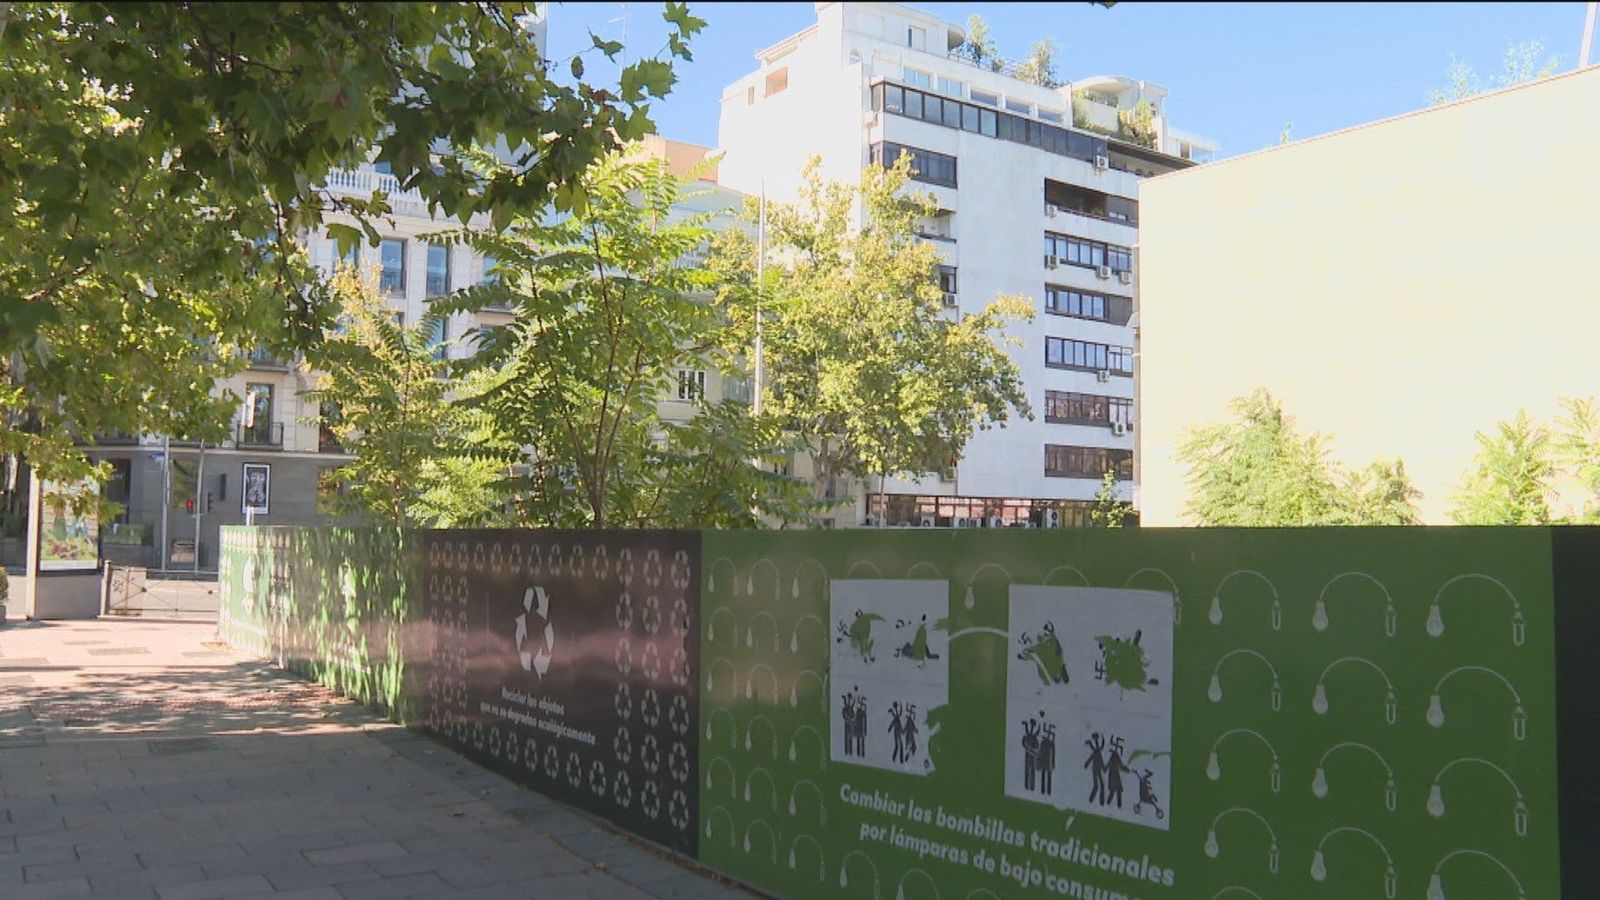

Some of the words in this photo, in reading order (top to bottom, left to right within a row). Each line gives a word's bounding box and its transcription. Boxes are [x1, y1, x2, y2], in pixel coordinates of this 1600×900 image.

[840, 783, 906, 817] Cambiar
[907, 799, 933, 823] las
[936, 805, 1026, 847] bombillas
[1030, 831, 1175, 886] tradicionales
[859, 823, 888, 841] por
[889, 824, 969, 865] lámparas
[973, 849, 996, 873] de
[1000, 853, 1043, 888] bajo
[1047, 873, 1142, 900] consu
